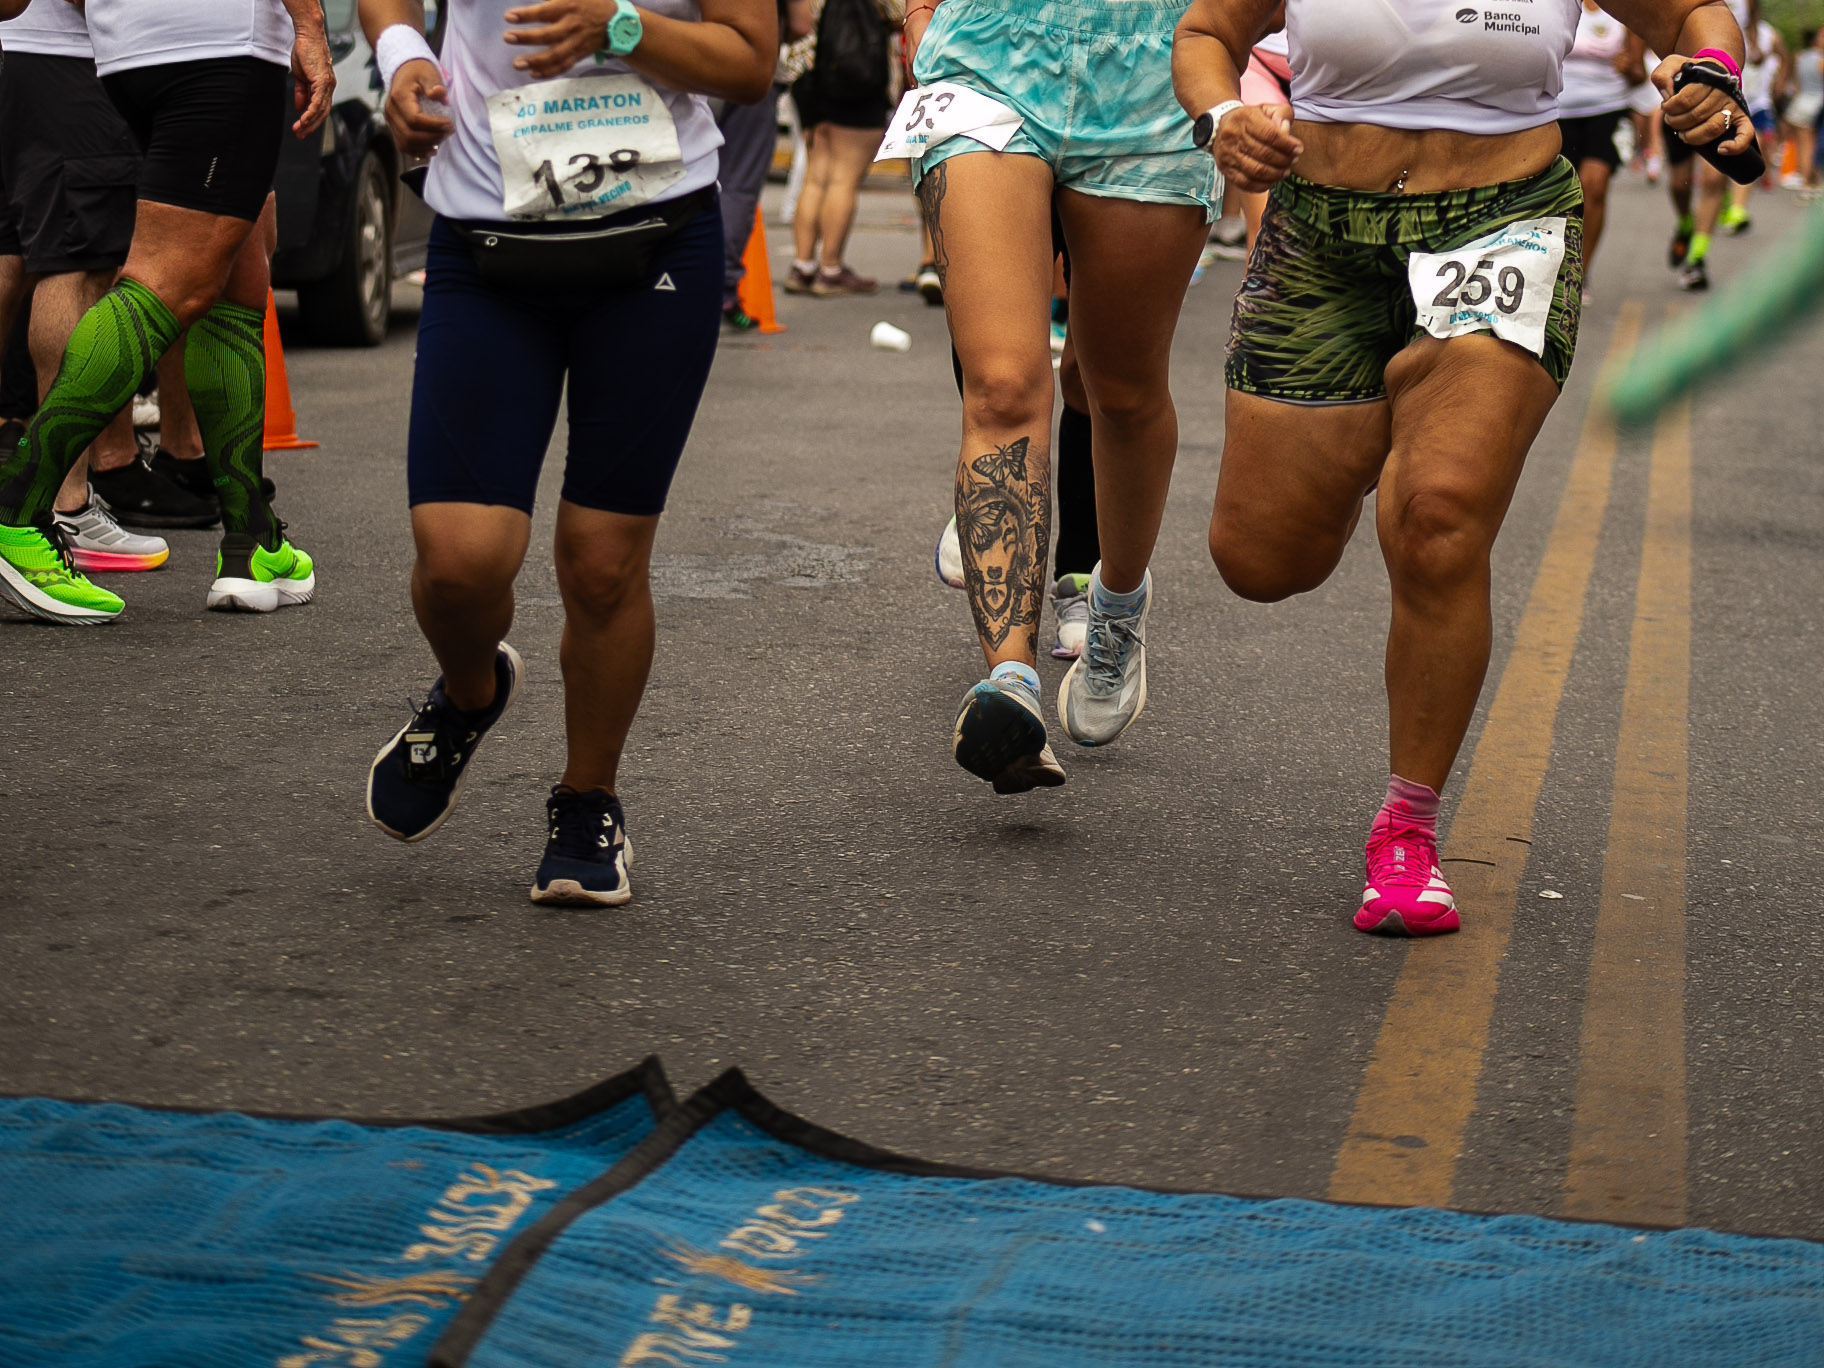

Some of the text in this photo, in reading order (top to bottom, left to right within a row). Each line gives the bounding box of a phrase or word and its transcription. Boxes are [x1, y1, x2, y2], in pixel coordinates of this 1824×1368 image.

[1484, 11, 1521, 22] Banco
[1484, 21, 1541, 36] Municipal
[543, 92, 641, 114] MARATON
[577, 114, 650, 130] GRANEROS
[1491, 236, 1548, 255] RANEROS
[1431, 260, 1525, 315] 259
